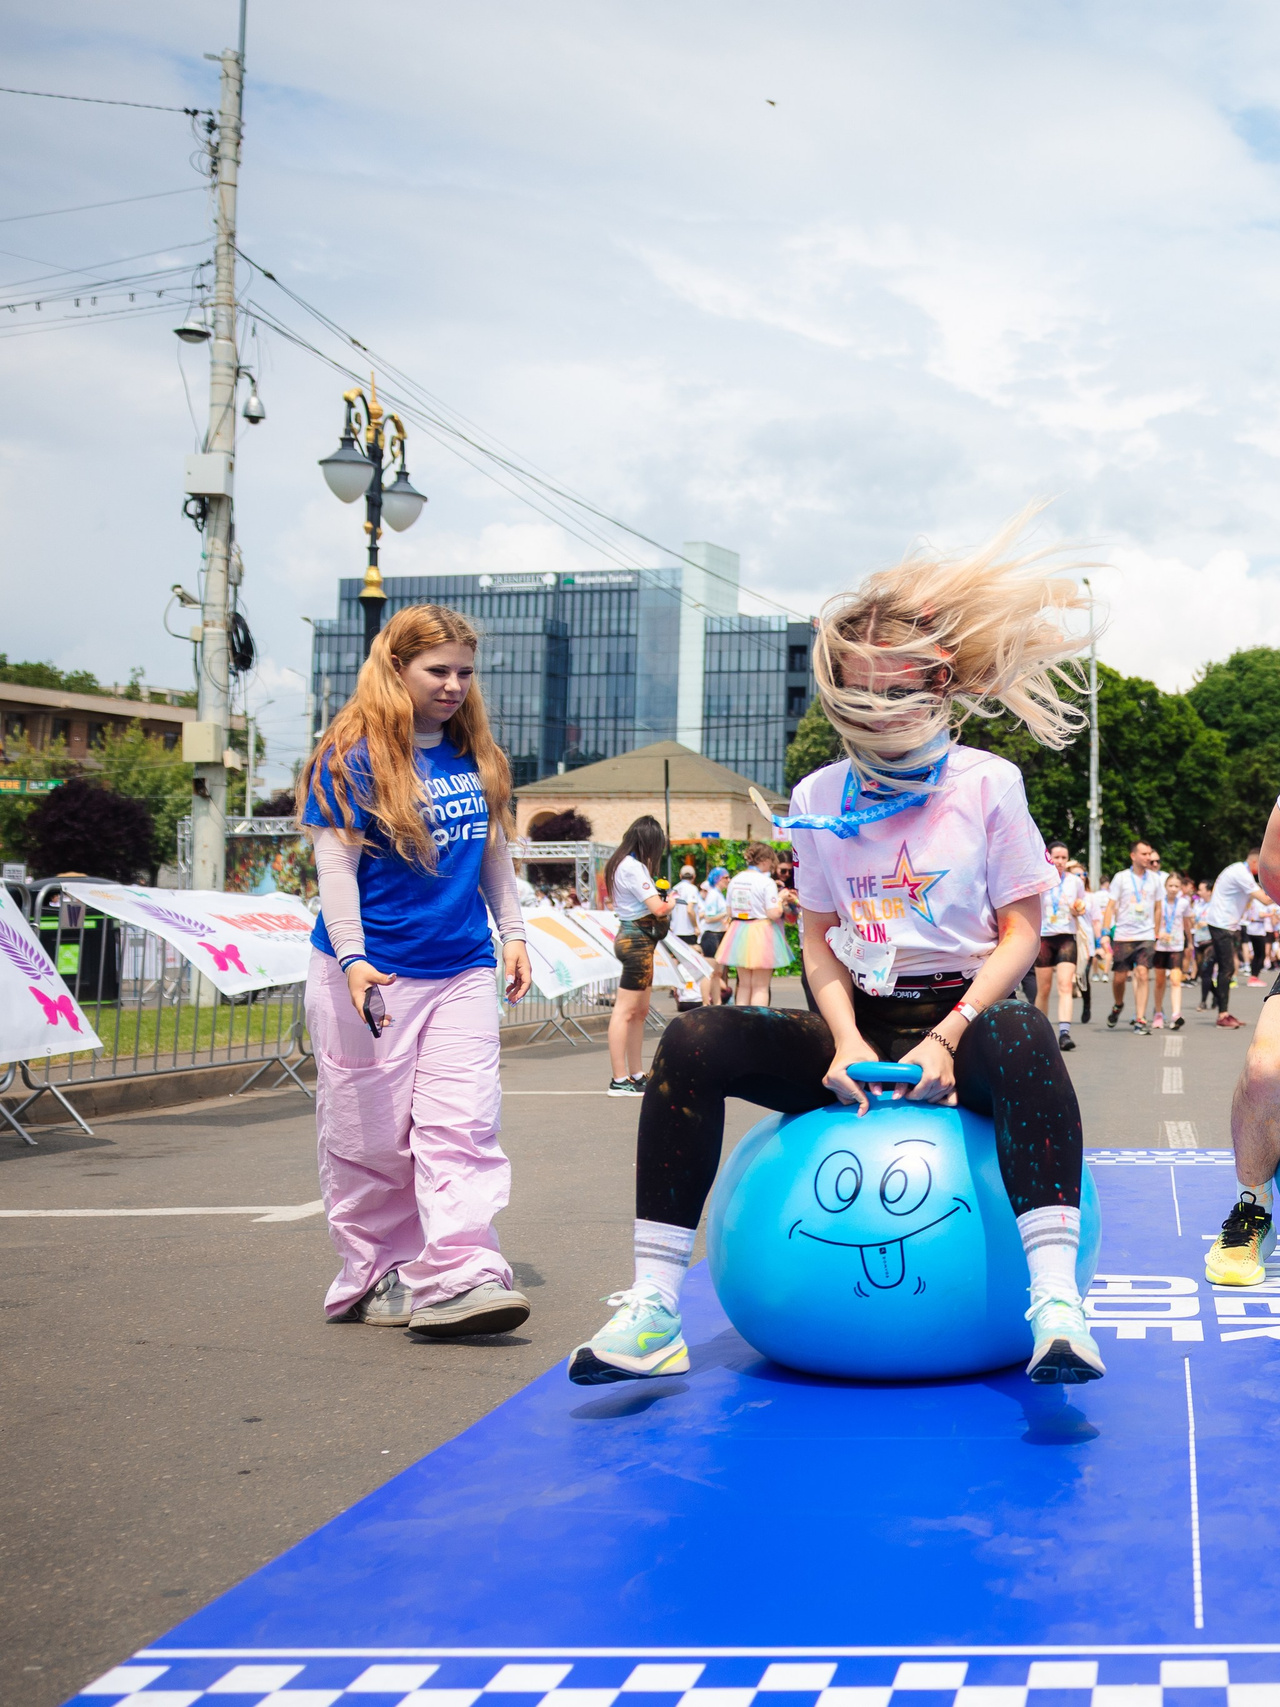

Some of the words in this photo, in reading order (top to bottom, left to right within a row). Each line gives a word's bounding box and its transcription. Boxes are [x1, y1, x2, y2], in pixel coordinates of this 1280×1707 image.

[424, 772, 475, 799] COLOR
[419, 791, 488, 822] mazin
[846, 875, 878, 898] THE
[851, 897, 906, 922] COLOR
[856, 923, 887, 943] RUN
